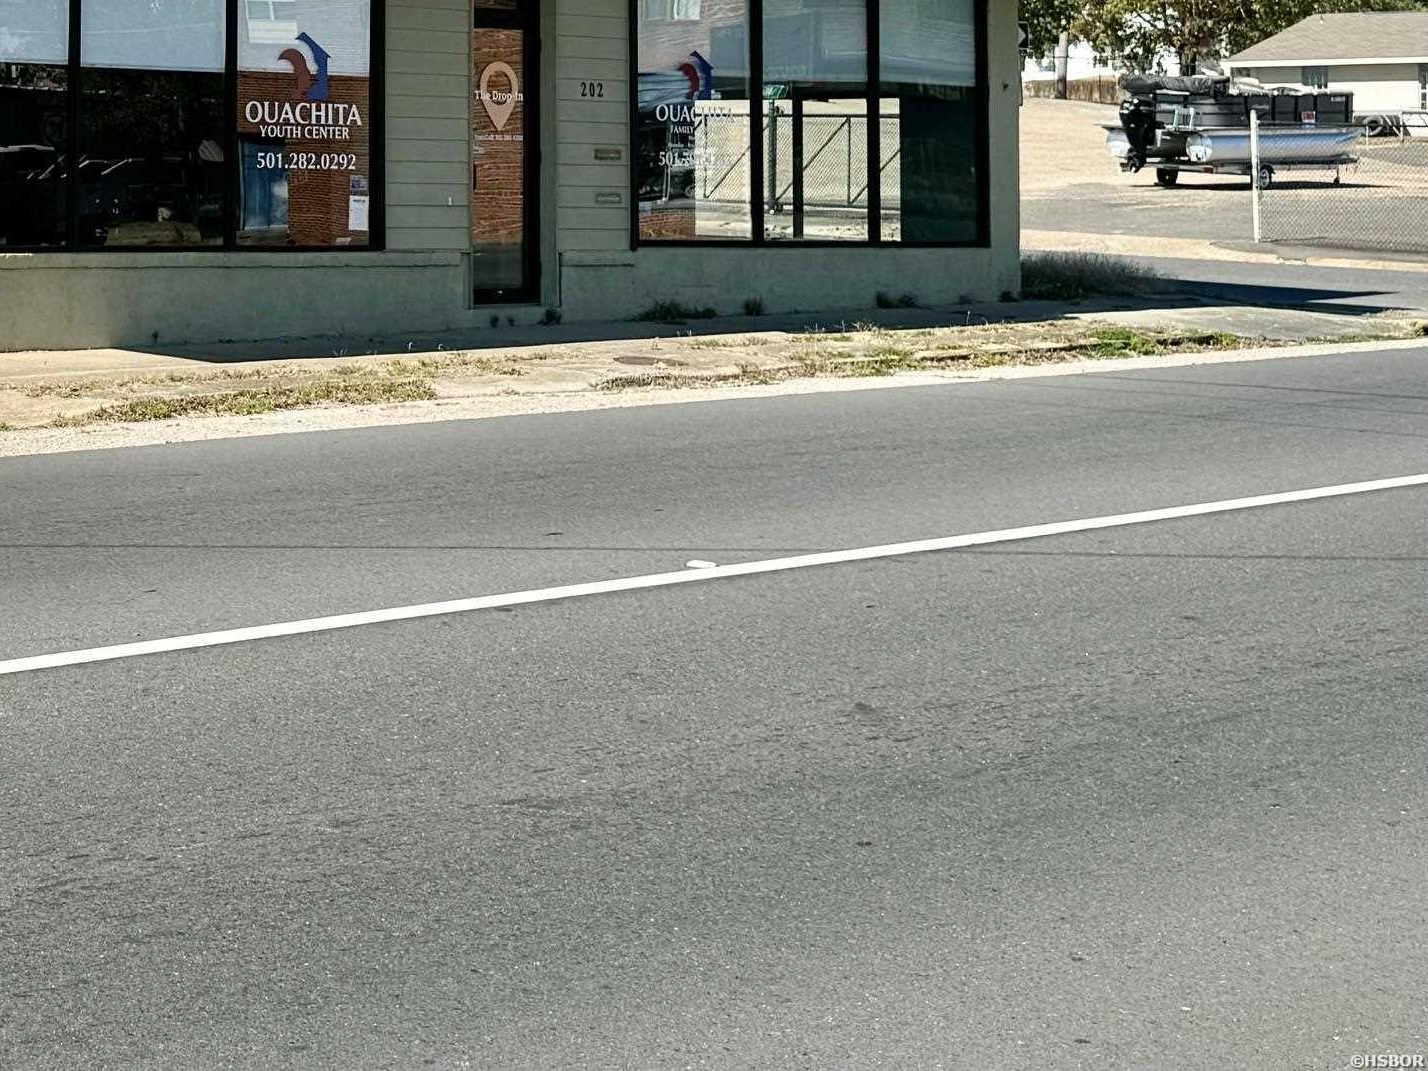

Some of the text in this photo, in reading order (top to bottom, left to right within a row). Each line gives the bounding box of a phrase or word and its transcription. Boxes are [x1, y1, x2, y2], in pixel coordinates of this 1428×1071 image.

[580, 81, 604, 98] 202
[245, 100, 363, 126] OUACHITA
[259, 125, 350, 140] YOUTH CENTER
[256, 152, 357, 170] 501.282.0292
